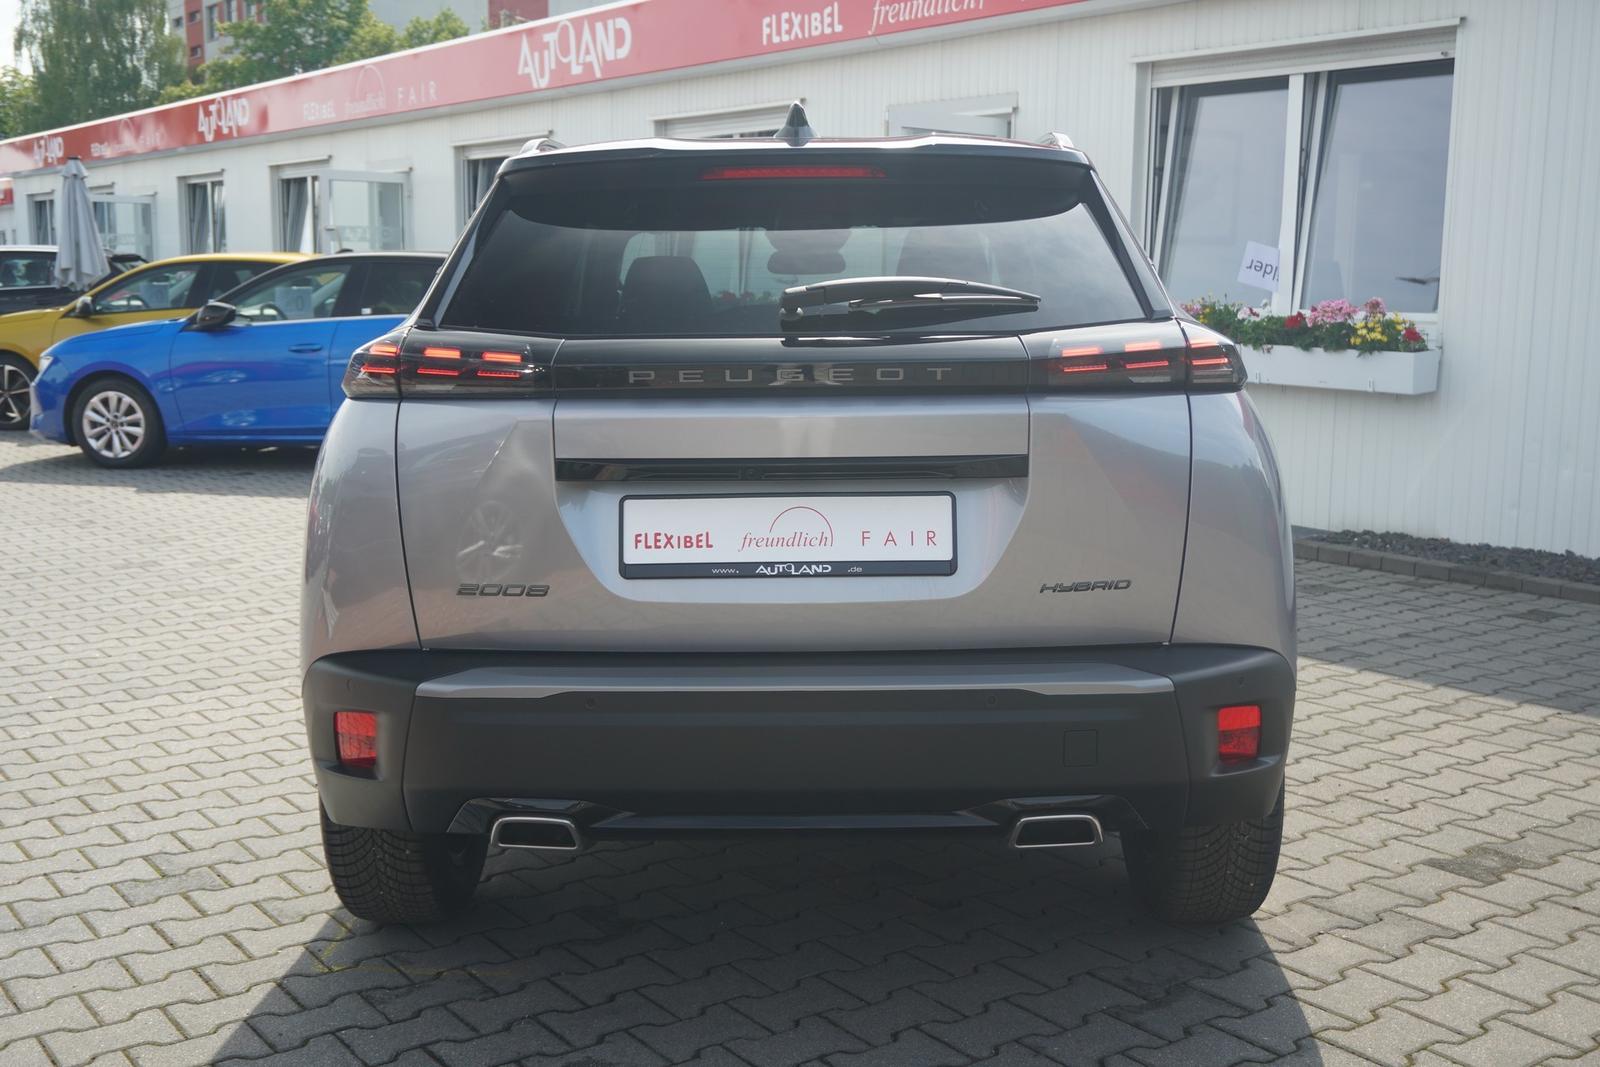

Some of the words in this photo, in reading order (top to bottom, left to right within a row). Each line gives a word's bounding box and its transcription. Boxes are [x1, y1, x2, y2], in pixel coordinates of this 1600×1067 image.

[762, 3, 843, 46] FLEXIBEL
[517, 17, 632, 89] AUTOLAND
[397, 81, 437, 107] FAIR
[1246, 258, 1279, 281] lder
[628, 367, 954, 384] PEUGEOT
[634, 531, 714, 550] FLEXIBEL
[738, 530, 829, 553] freundlich
[861, 530, 937, 547] FAIR
[755, 563, 832, 577] AUTOLAND
[456, 583, 550, 597] 2008
[1040, 579, 1132, 594] HYBRID
